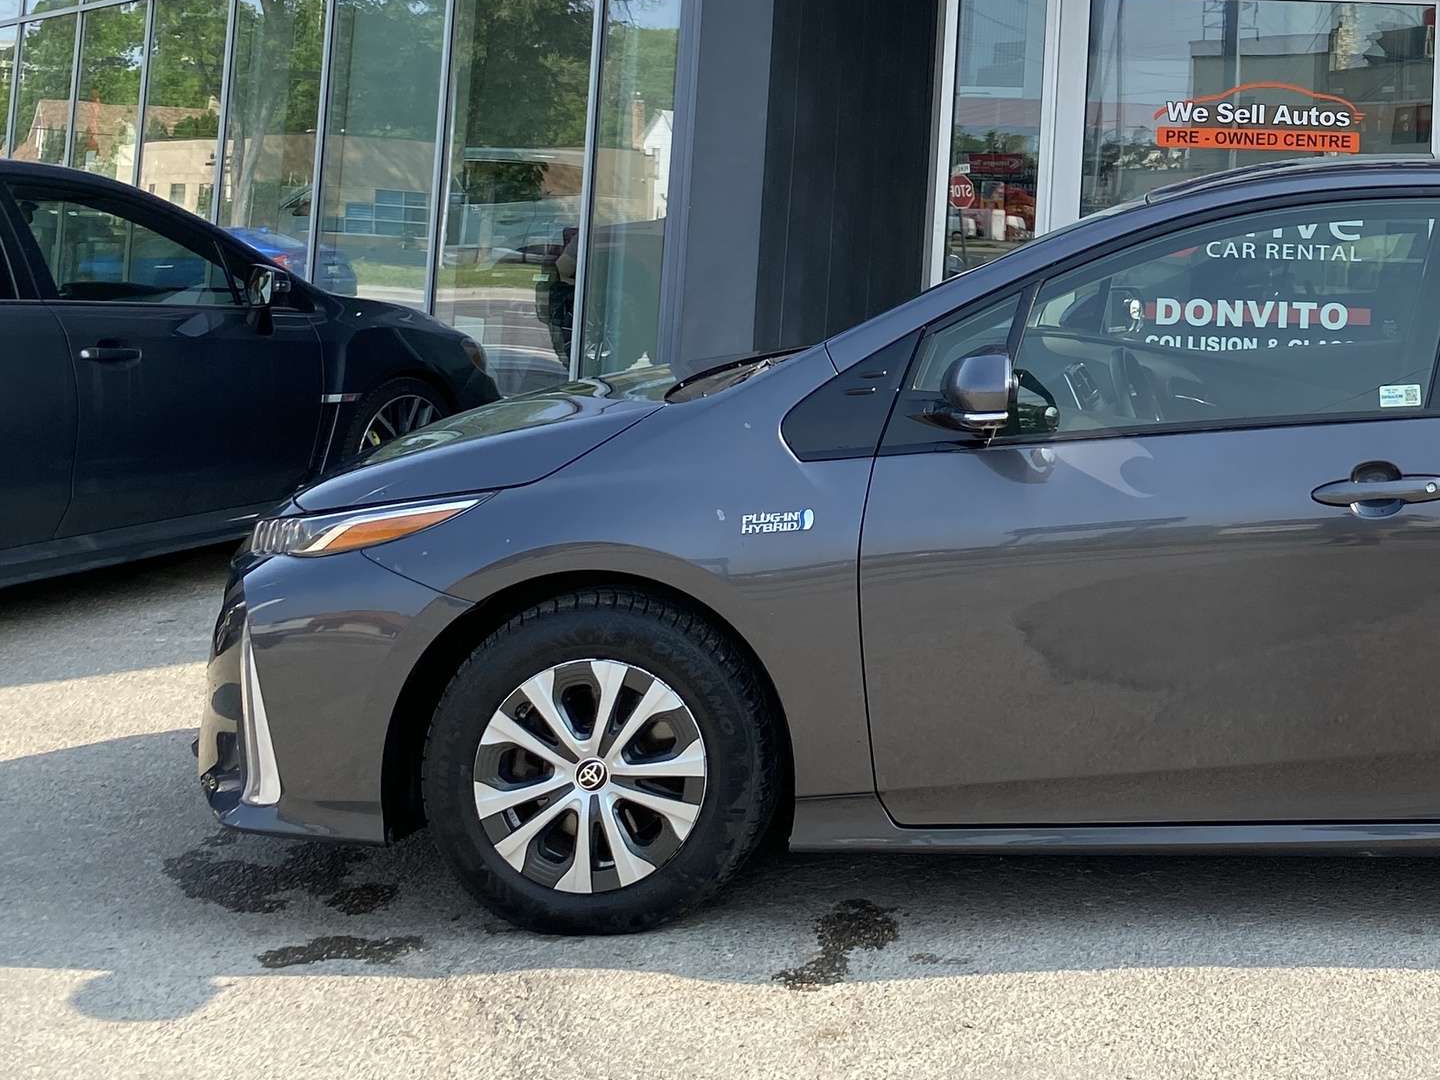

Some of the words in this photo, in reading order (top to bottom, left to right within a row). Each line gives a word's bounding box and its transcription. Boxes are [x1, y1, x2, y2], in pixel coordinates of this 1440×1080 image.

[1166, 101, 1209, 123] We
[1216, 103, 1265, 125] Sell
[1272, 104, 1351, 128] Autos
[1165, 130, 1199, 144] PRE
[1215, 131, 1278, 146] OWNED
[1283, 133, 1351, 149] CENTRE
[1206, 240, 1256, 259] CAR
[1265, 242, 1363, 262] RENTAL
[1155, 296, 1349, 331] DONVITO
[1145, 334, 1258, 352] COLLISION
[742, 511, 800, 524] PLUG-IN
[741, 522, 800, 534] HYBRID
